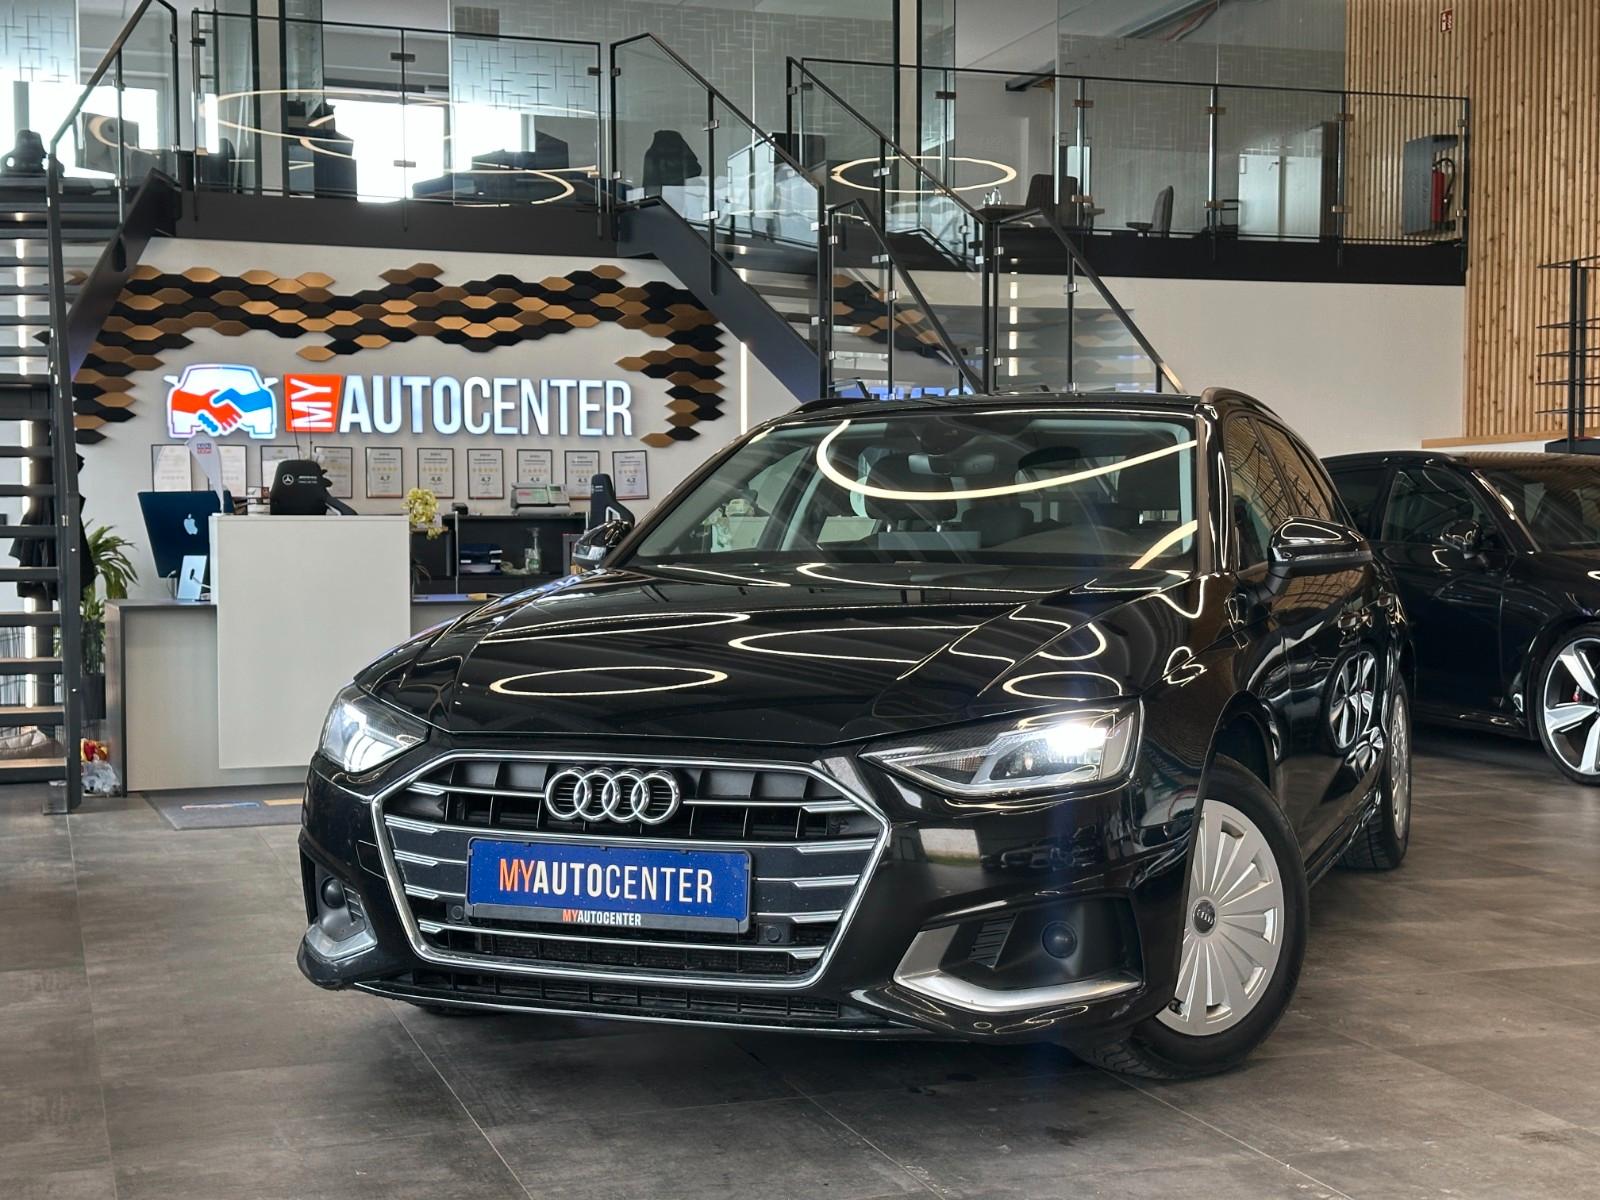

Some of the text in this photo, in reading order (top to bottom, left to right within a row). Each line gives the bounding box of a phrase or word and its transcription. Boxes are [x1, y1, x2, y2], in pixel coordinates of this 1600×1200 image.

[289, 374, 633, 436] MY AUTOCENTER
[499, 858, 713, 904] MYAUTOCENTER
[562, 908, 642, 927] MYAUTOCENTER
